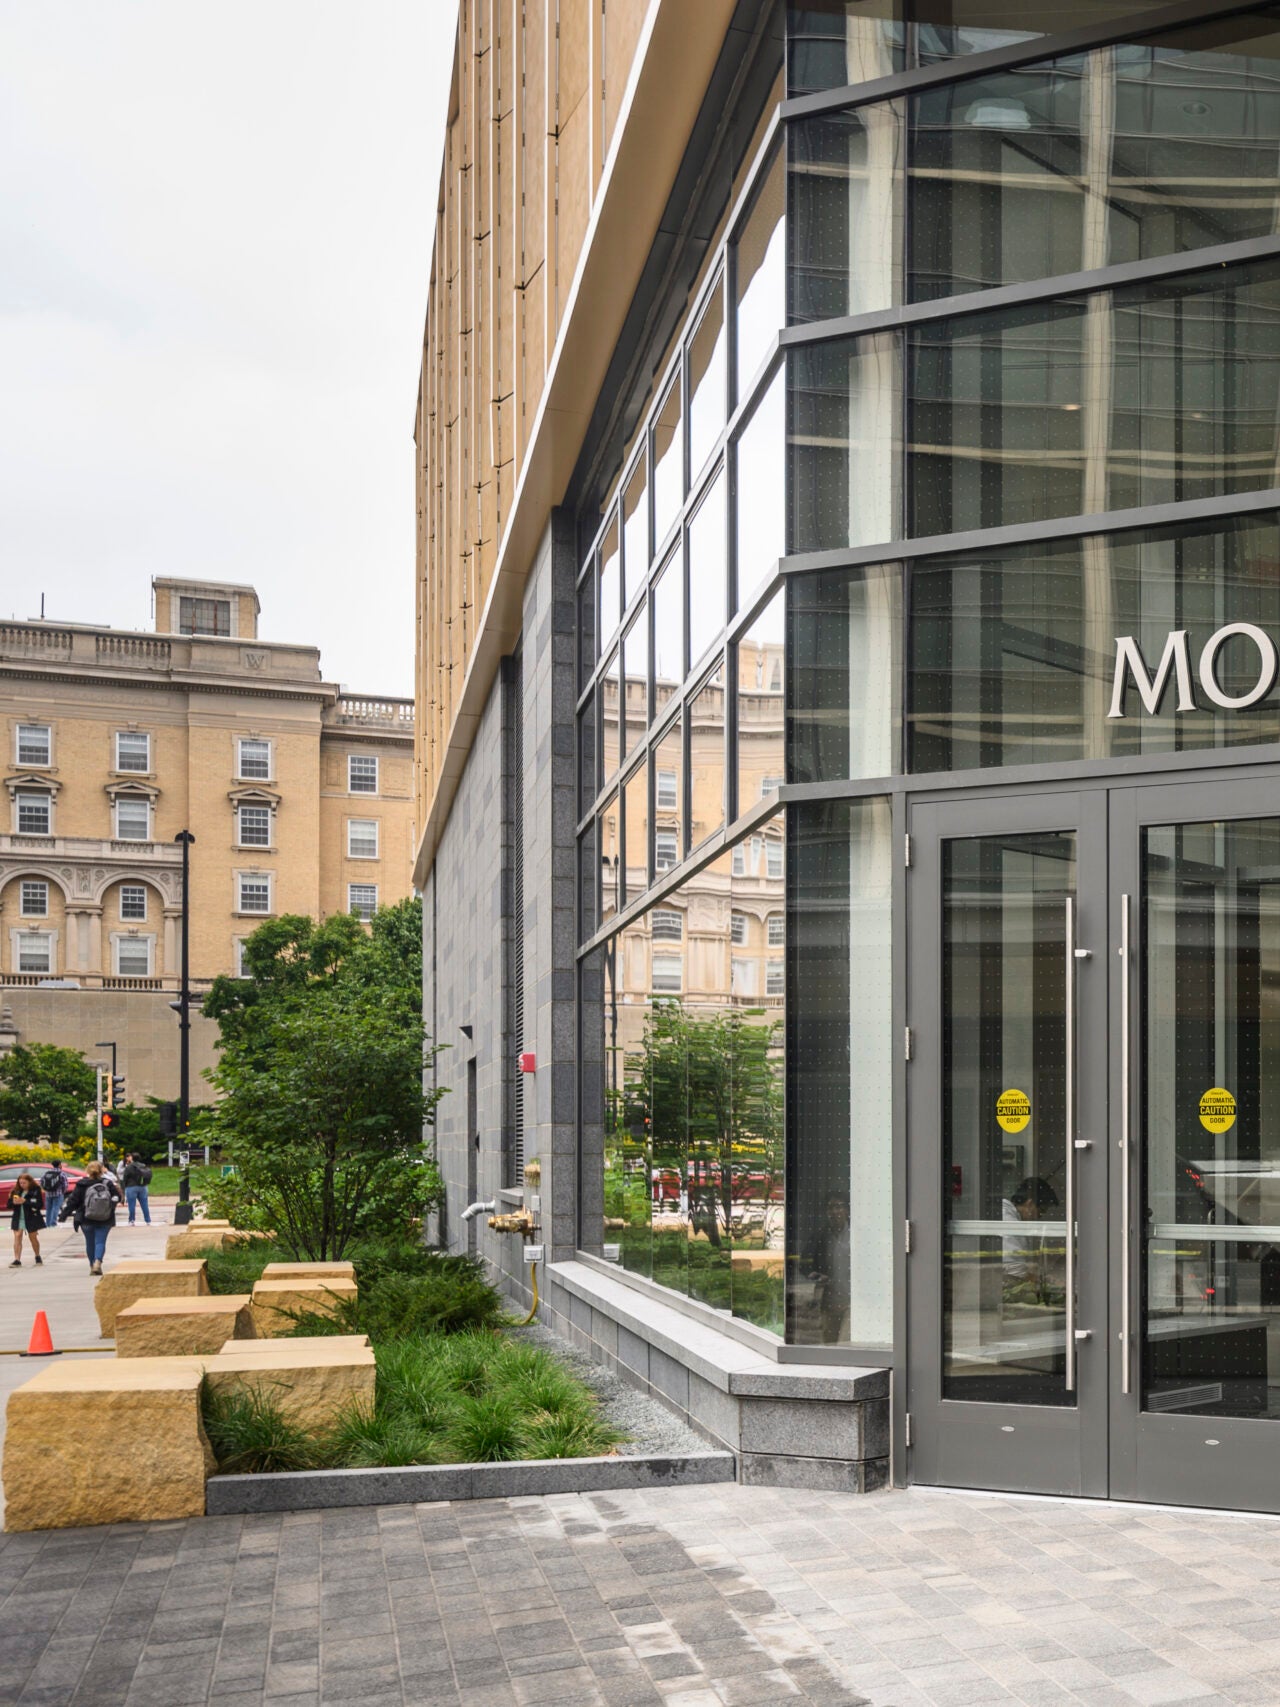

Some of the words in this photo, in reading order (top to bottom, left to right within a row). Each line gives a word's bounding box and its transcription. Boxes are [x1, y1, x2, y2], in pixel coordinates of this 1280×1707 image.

[246, 654, 264, 669] W
[997, 1106, 1029, 1115] CAUTION
[1200, 1106, 1235, 1115] CAUTION
